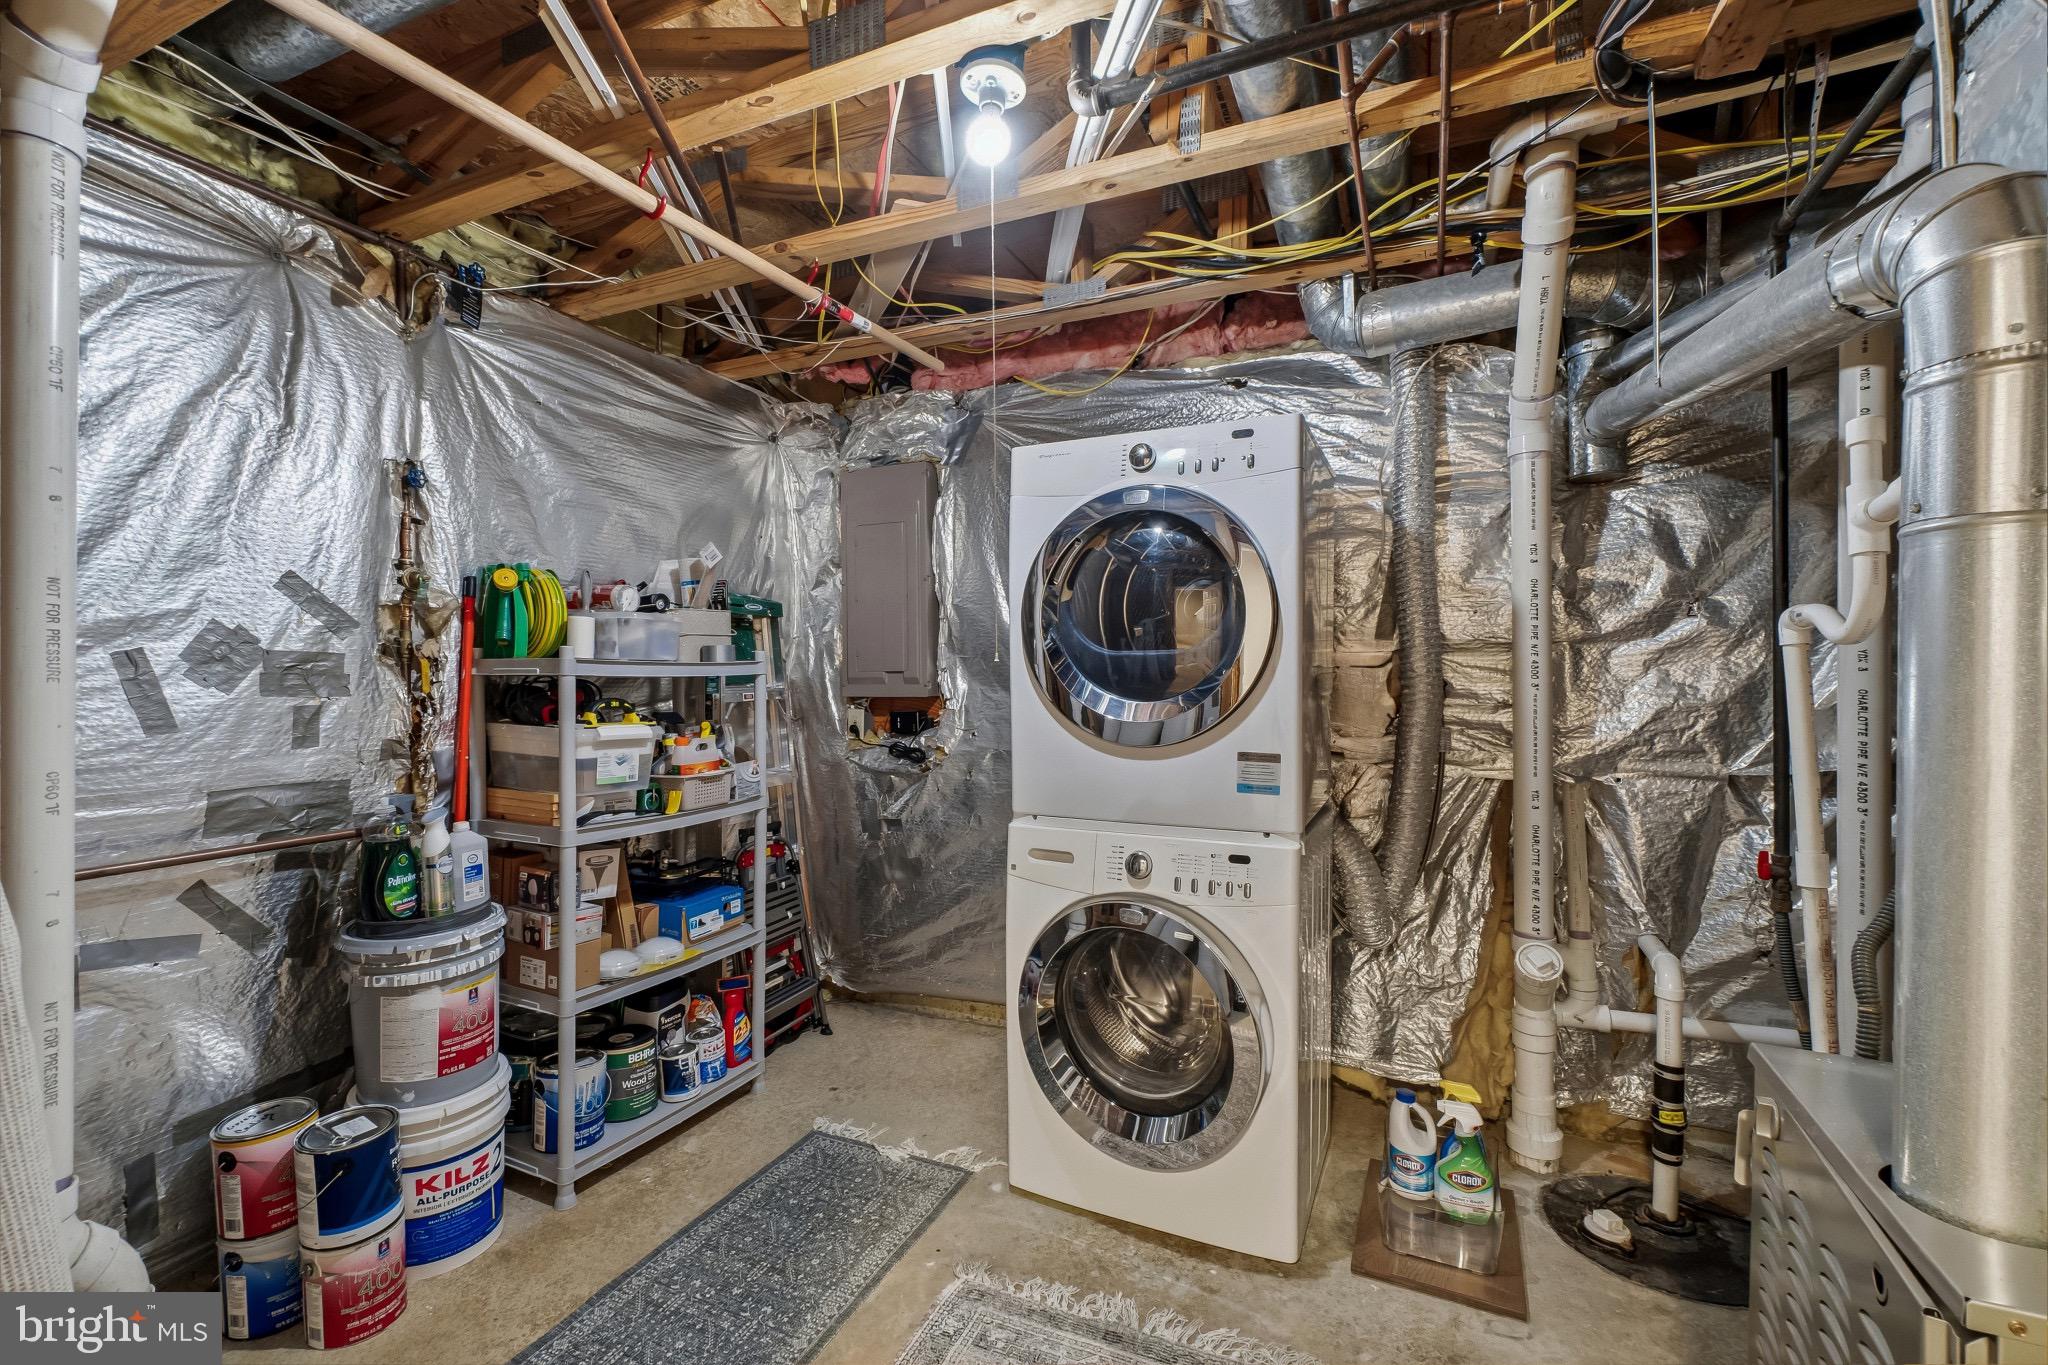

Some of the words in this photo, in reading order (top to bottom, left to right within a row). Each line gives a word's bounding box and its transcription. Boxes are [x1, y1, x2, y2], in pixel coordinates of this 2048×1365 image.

[51, 150, 65, 173] NOT
[51, 176, 65, 200] FOR
[51, 201, 65, 260] PRESSURE
[46, 576, 61, 599] NOT
[46, 602, 61, 624] FOR
[1530, 624, 1539, 641] PIPE
[46, 628, 61, 684] PRESSURE
[1857, 740, 1869, 759] PIPE
[1531, 869, 1541, 886] PIPE
[43, 1001, 59, 1023] NOT
[43, 1027, 59, 1048] FOR
[43, 1052, 59, 1110] PRESSURE
[622, 1076, 648, 1090] Wood
[415, 1151, 490, 1197] KILZ
[1396, 1156, 1421, 1172] CLOROX
[416, 1171, 490, 1207] ALL-PURPOSE
[1452, 1173, 1482, 1186] CLOROX
